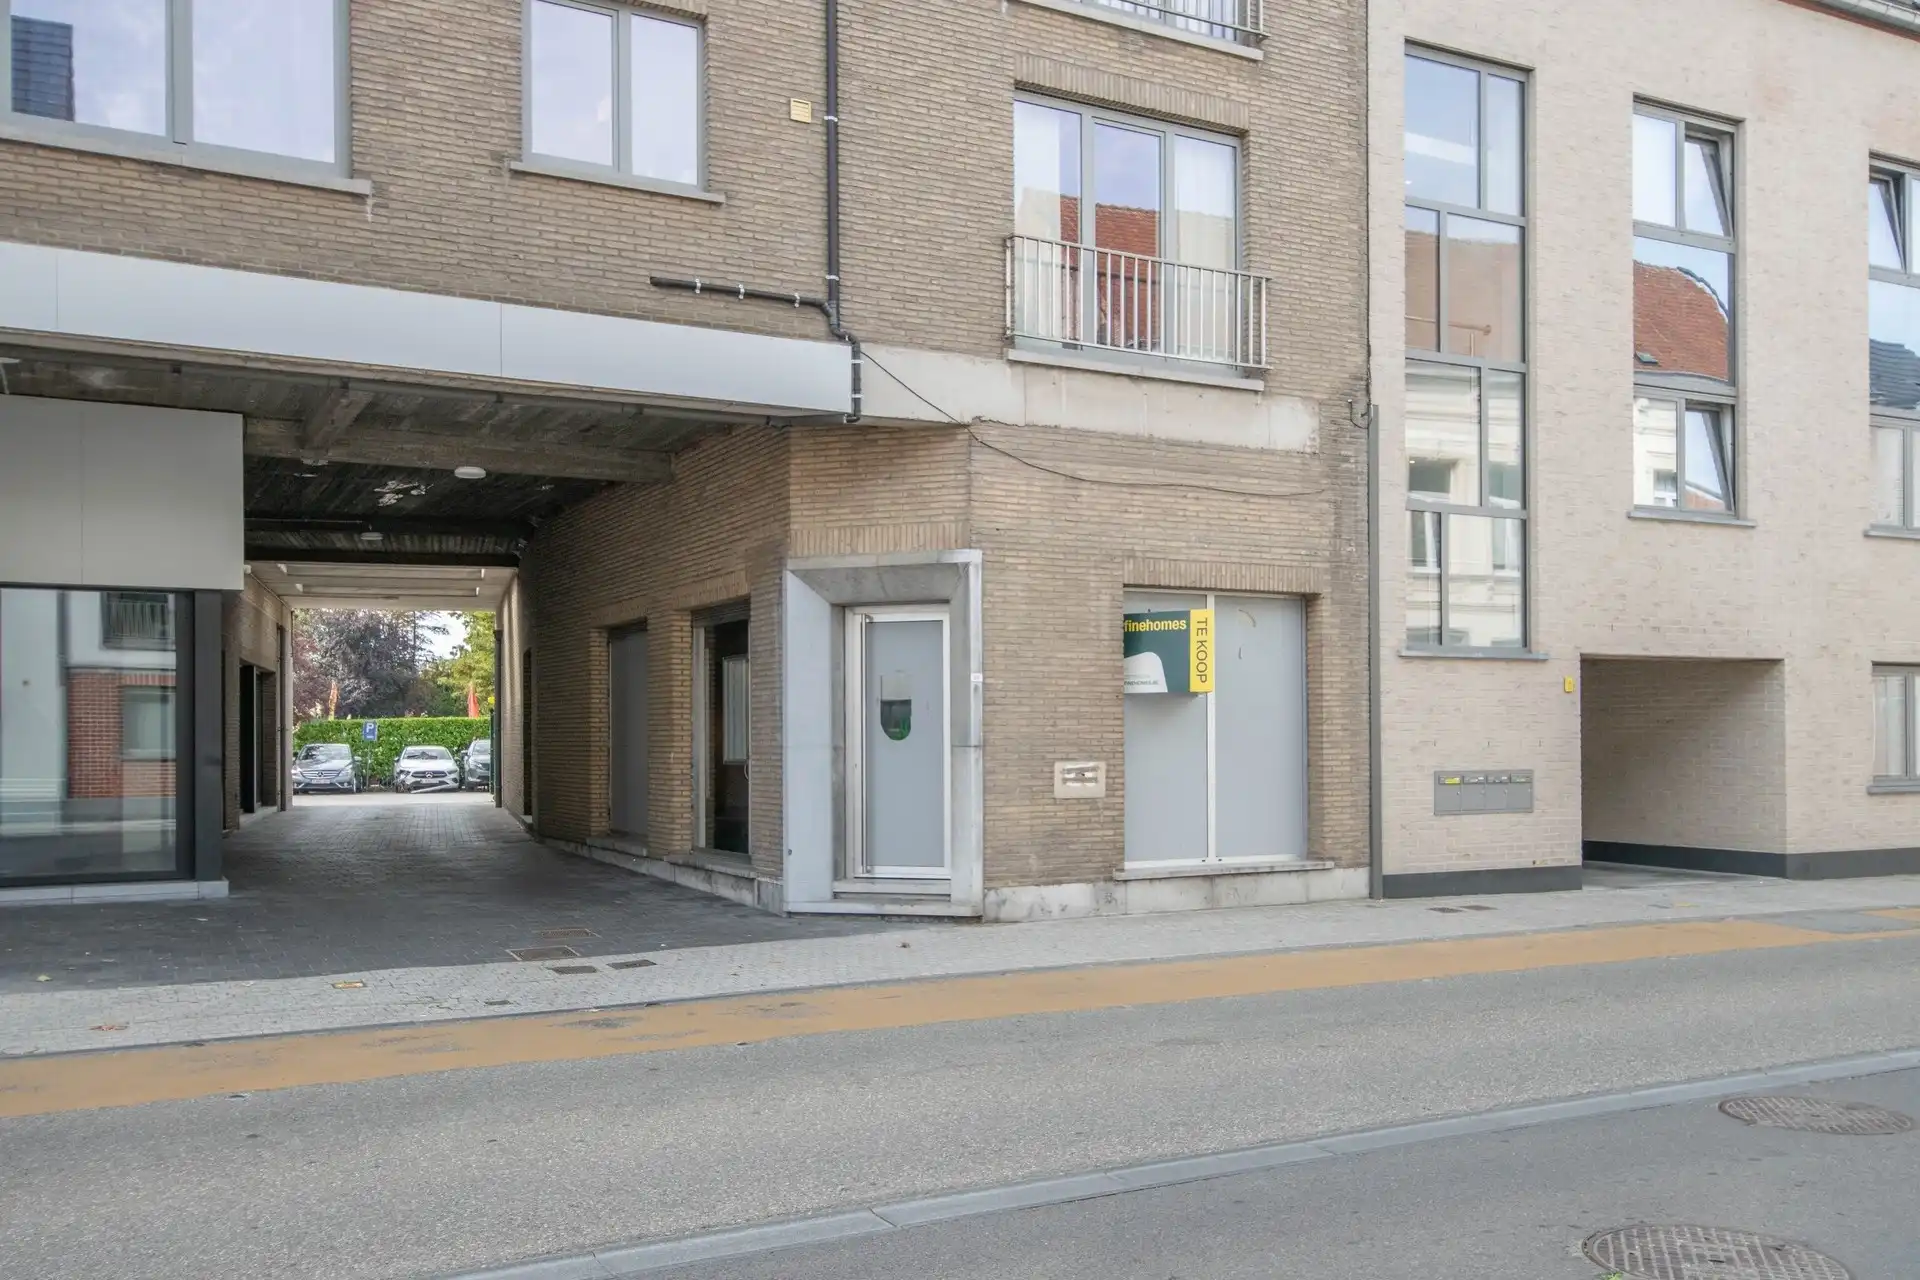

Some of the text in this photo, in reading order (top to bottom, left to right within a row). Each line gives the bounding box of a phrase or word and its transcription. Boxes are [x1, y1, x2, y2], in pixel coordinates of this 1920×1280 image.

[1123, 619, 1187, 632] finehomes
[1196, 617, 1208, 684] TE KOOP
[366, 722, 375, 733] P
